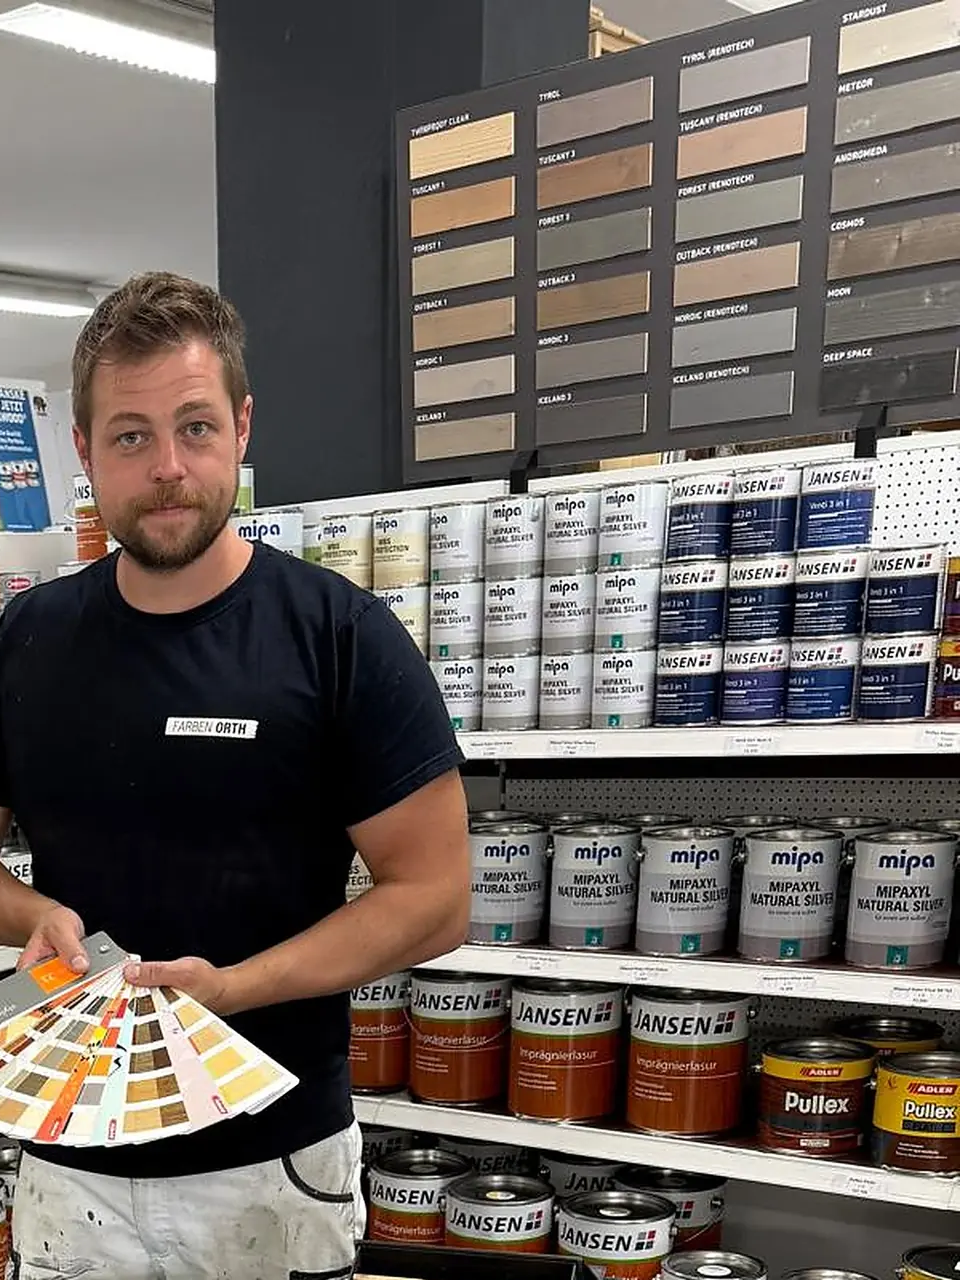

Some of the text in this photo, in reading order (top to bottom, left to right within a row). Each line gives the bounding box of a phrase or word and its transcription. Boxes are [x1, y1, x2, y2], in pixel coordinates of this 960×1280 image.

[842, 5, 887, 24] STARDUST
[682, 38, 755, 65] TYROL (RENOTECH)
[839, 77, 873, 93] METEOR
[539, 90, 561, 101] TYROL
[680, 104, 763, 132] TUSCANY (RENOTECH)
[539, 152, 569, 165] TUSCANY
[834, 145, 888, 164] ANDROMEDA
[412, 183, 440, 196] TUSCANY
[678, 173, 754, 197] FOREST (RENOTECH)
[539, 215, 563, 227] FOREST
[830, 217, 865, 232] COSMOS
[414, 242, 435, 253] FOREST
[676, 237, 758, 262] OUTBACK (RENOTECH)
[538, 275, 569, 288] OUTBACK
[827, 287, 852, 298] MOON
[414, 301, 442, 312] OUTBACK
[674, 304, 748, 324] NORDIC (RENOTECH)
[538, 336, 562, 346] NORDIC
[823, 348, 873, 363] DEEP SPACE
[673, 366, 750, 384] ICELAND (RENOTECH)
[538, 394, 565, 405] ICELAND
[417, 413, 440, 422] ICELAND
[808, 469, 860, 486] JANSEN
[554, 498, 585, 513] mipa
[606, 492, 635, 508] mipa
[493, 504, 522, 521] mipa
[238, 520, 281, 537] mipa
[550, 580, 579, 595] mipa
[605, 575, 636, 591] mipa
[444, 663, 474, 678] mipa
[603, 657, 633, 672] mipa
[172, 721, 246, 734] FARBEN ORTH
[483, 840, 531, 862] mipa
[574, 842, 623, 864] mipa
[670, 845, 720, 869] mipa
[770, 847, 824, 871] mipa
[877, 849, 936, 876] mipa
[482, 870, 530, 884] MIPAXYL
[573, 872, 619, 886] MIPAXYL
[668, 878, 718, 892] MIPAXYL
[557, 883, 635, 898] NATURAL SILVER
[769, 880, 821, 895] MIPAXYL
[875, 885, 932, 899] MIPAXYL
[650, 887, 729, 905] NATURAL SILVER
[750, 892, 799, 909] NATURAL
[856, 897, 909, 914] NATURAL
[413, 988, 480, 1011] JANSEN
[515, 1001, 591, 1026] JANSEN
[634, 1009, 712, 1035] JANSEN
[519, 1047, 597, 1061] Imprägnierlasur
[637, 1056, 717, 1072] Imprägnierlasur
[917, 1085, 953, 1093] ADLER
[785, 1091, 849, 1114] Pullex
[905, 1101, 955, 1119] Pullex
[372, 1179, 434, 1205] JANSEN
[450, 1208, 522, 1233] JANSEN
[560, 1222, 632, 1252] JANSEN
